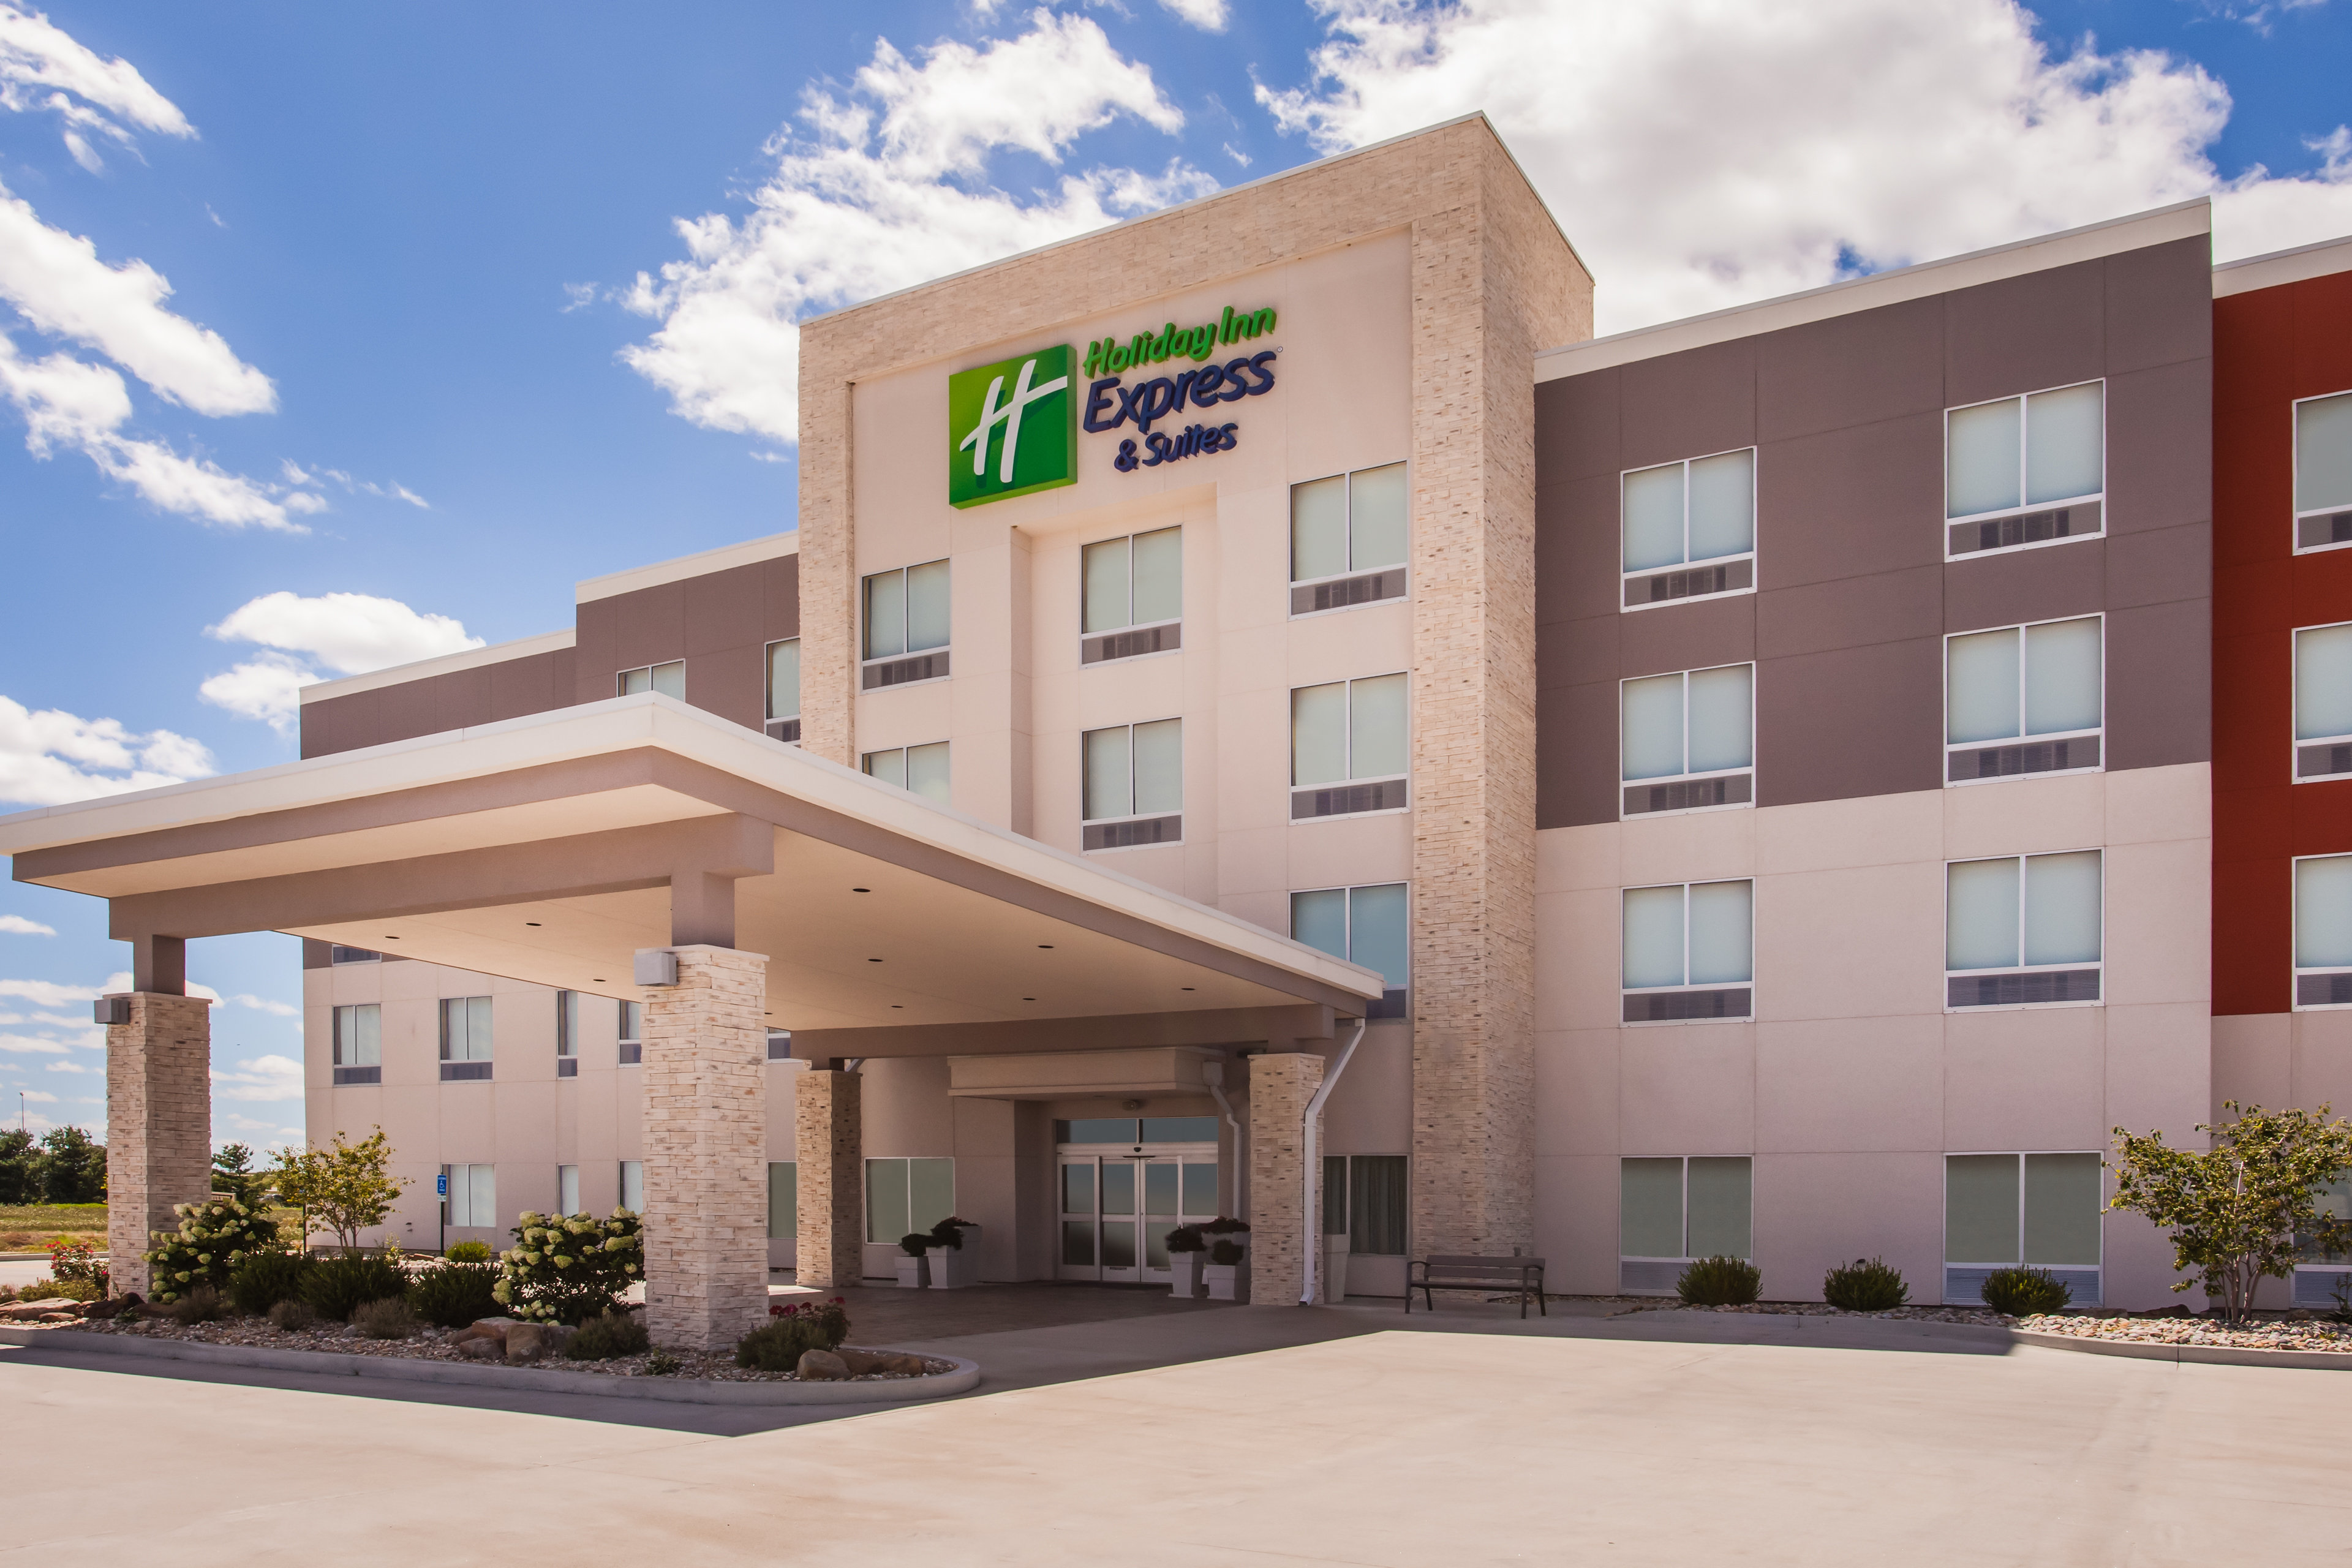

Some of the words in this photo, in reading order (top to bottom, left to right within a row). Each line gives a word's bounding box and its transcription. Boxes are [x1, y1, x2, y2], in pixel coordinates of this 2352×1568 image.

[1083, 322, 1218, 379] Holiday
[1218, 306, 1277, 347] Inn
[959, 359, 1068, 483] H
[1083, 351, 1277, 435] Express
[1114, 439, 1139, 473] &
[1142, 423, 1238, 467] Suites
